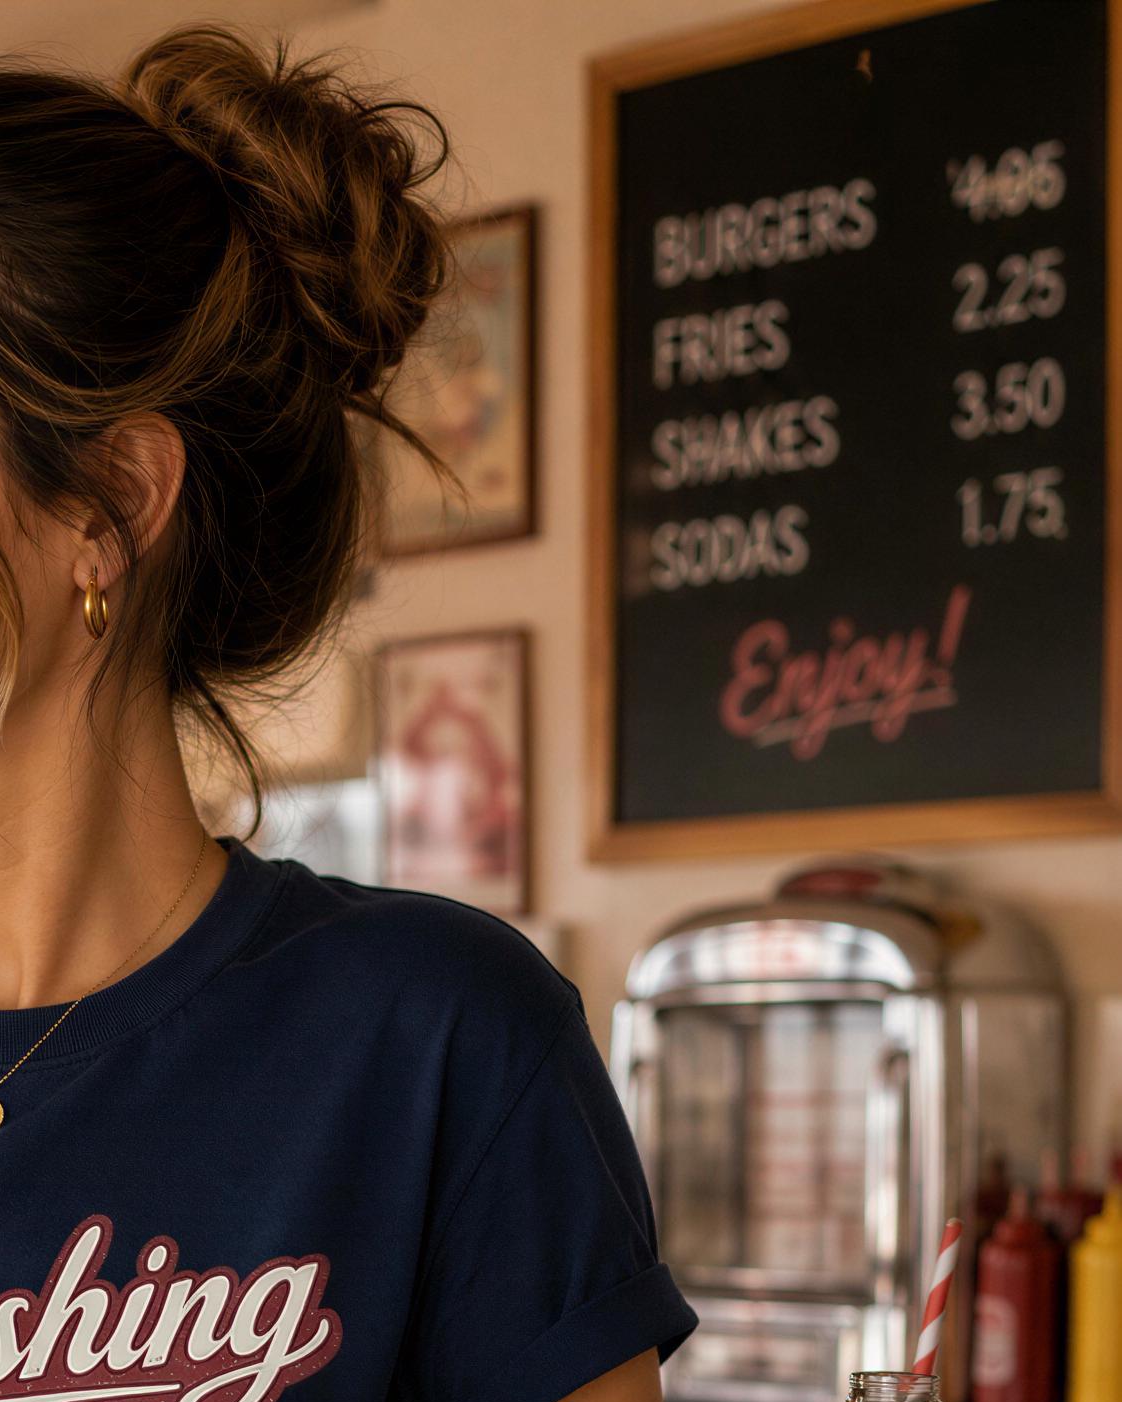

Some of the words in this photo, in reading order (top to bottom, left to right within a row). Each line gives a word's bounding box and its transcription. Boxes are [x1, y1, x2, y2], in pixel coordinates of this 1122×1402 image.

[654, 178, 877, 289] BURGERS
[653, 299, 791, 391] FRIES
[952, 247, 1066, 332] 2.25
[650, 396, 841, 491] SHAKES
[951, 357, 1066, 440] 3.50
[650, 504, 810, 592] SODAS
[720, 584, 971, 760] Enjoy!
